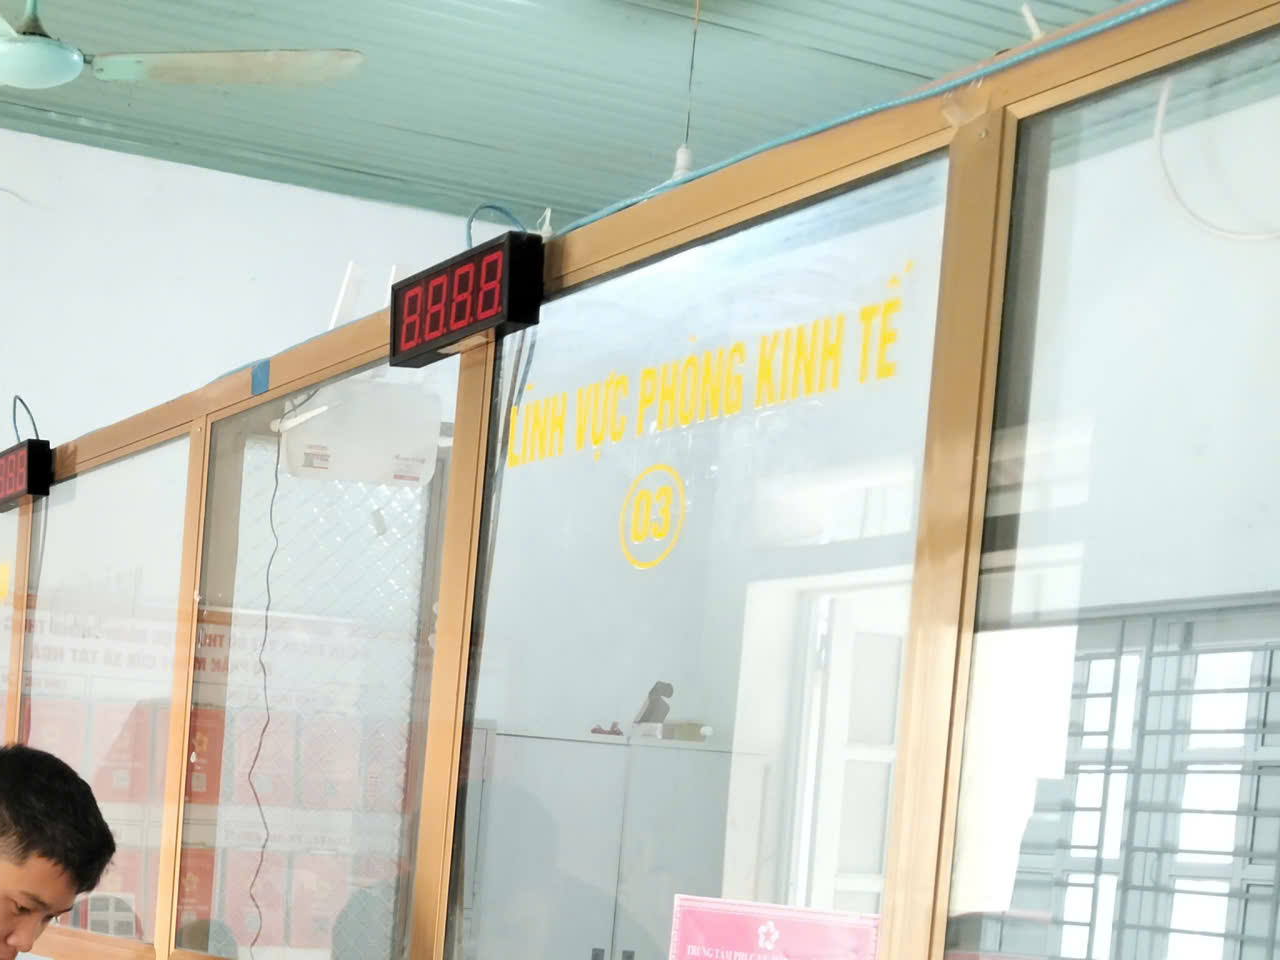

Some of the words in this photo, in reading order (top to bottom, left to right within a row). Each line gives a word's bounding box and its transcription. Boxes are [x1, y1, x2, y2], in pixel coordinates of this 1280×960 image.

[508, 384, 568, 468] LĨNH
[576, 368, 628, 460] VỰC
[635, 335, 746, 437] PHÒNG
[753, 313, 846, 409] KINH
[858, 261, 914, 384] TẾ
[631, 485, 673, 544] 03
